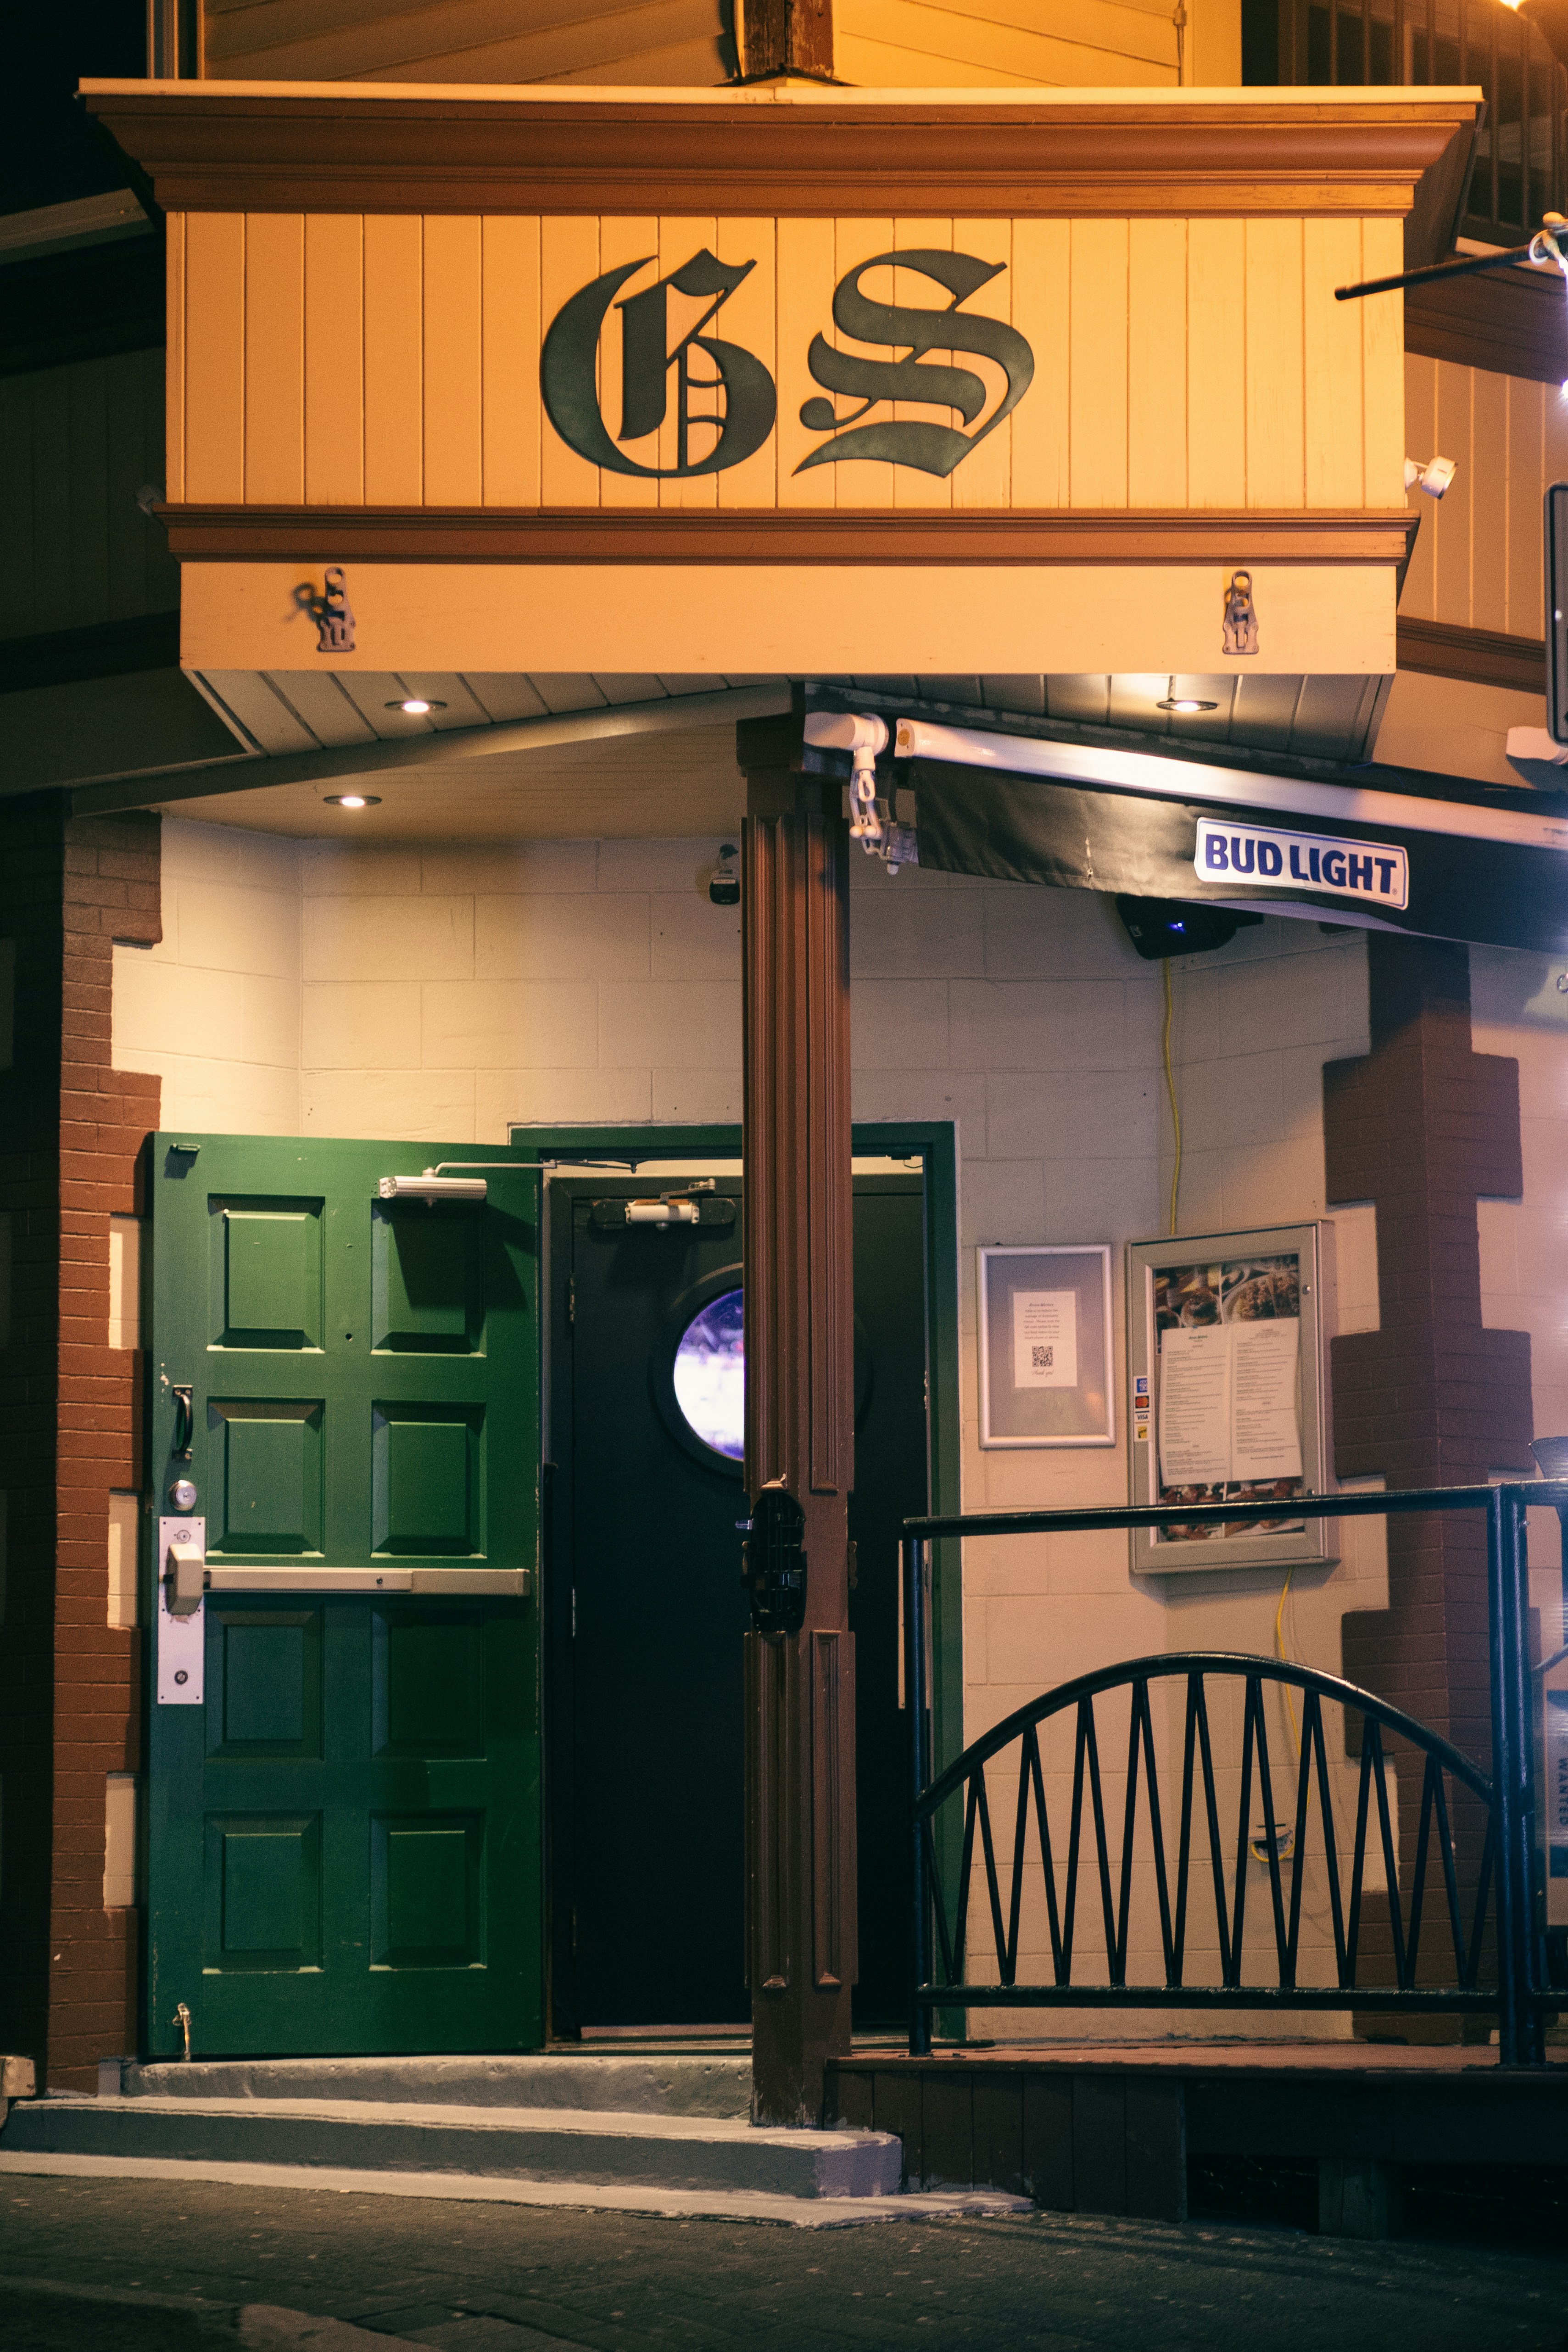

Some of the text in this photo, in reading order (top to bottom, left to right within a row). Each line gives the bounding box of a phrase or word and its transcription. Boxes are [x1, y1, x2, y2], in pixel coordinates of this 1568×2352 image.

[539, 248, 1035, 478] GS
[1205, 834, 1397, 894] BUD LIGHT
